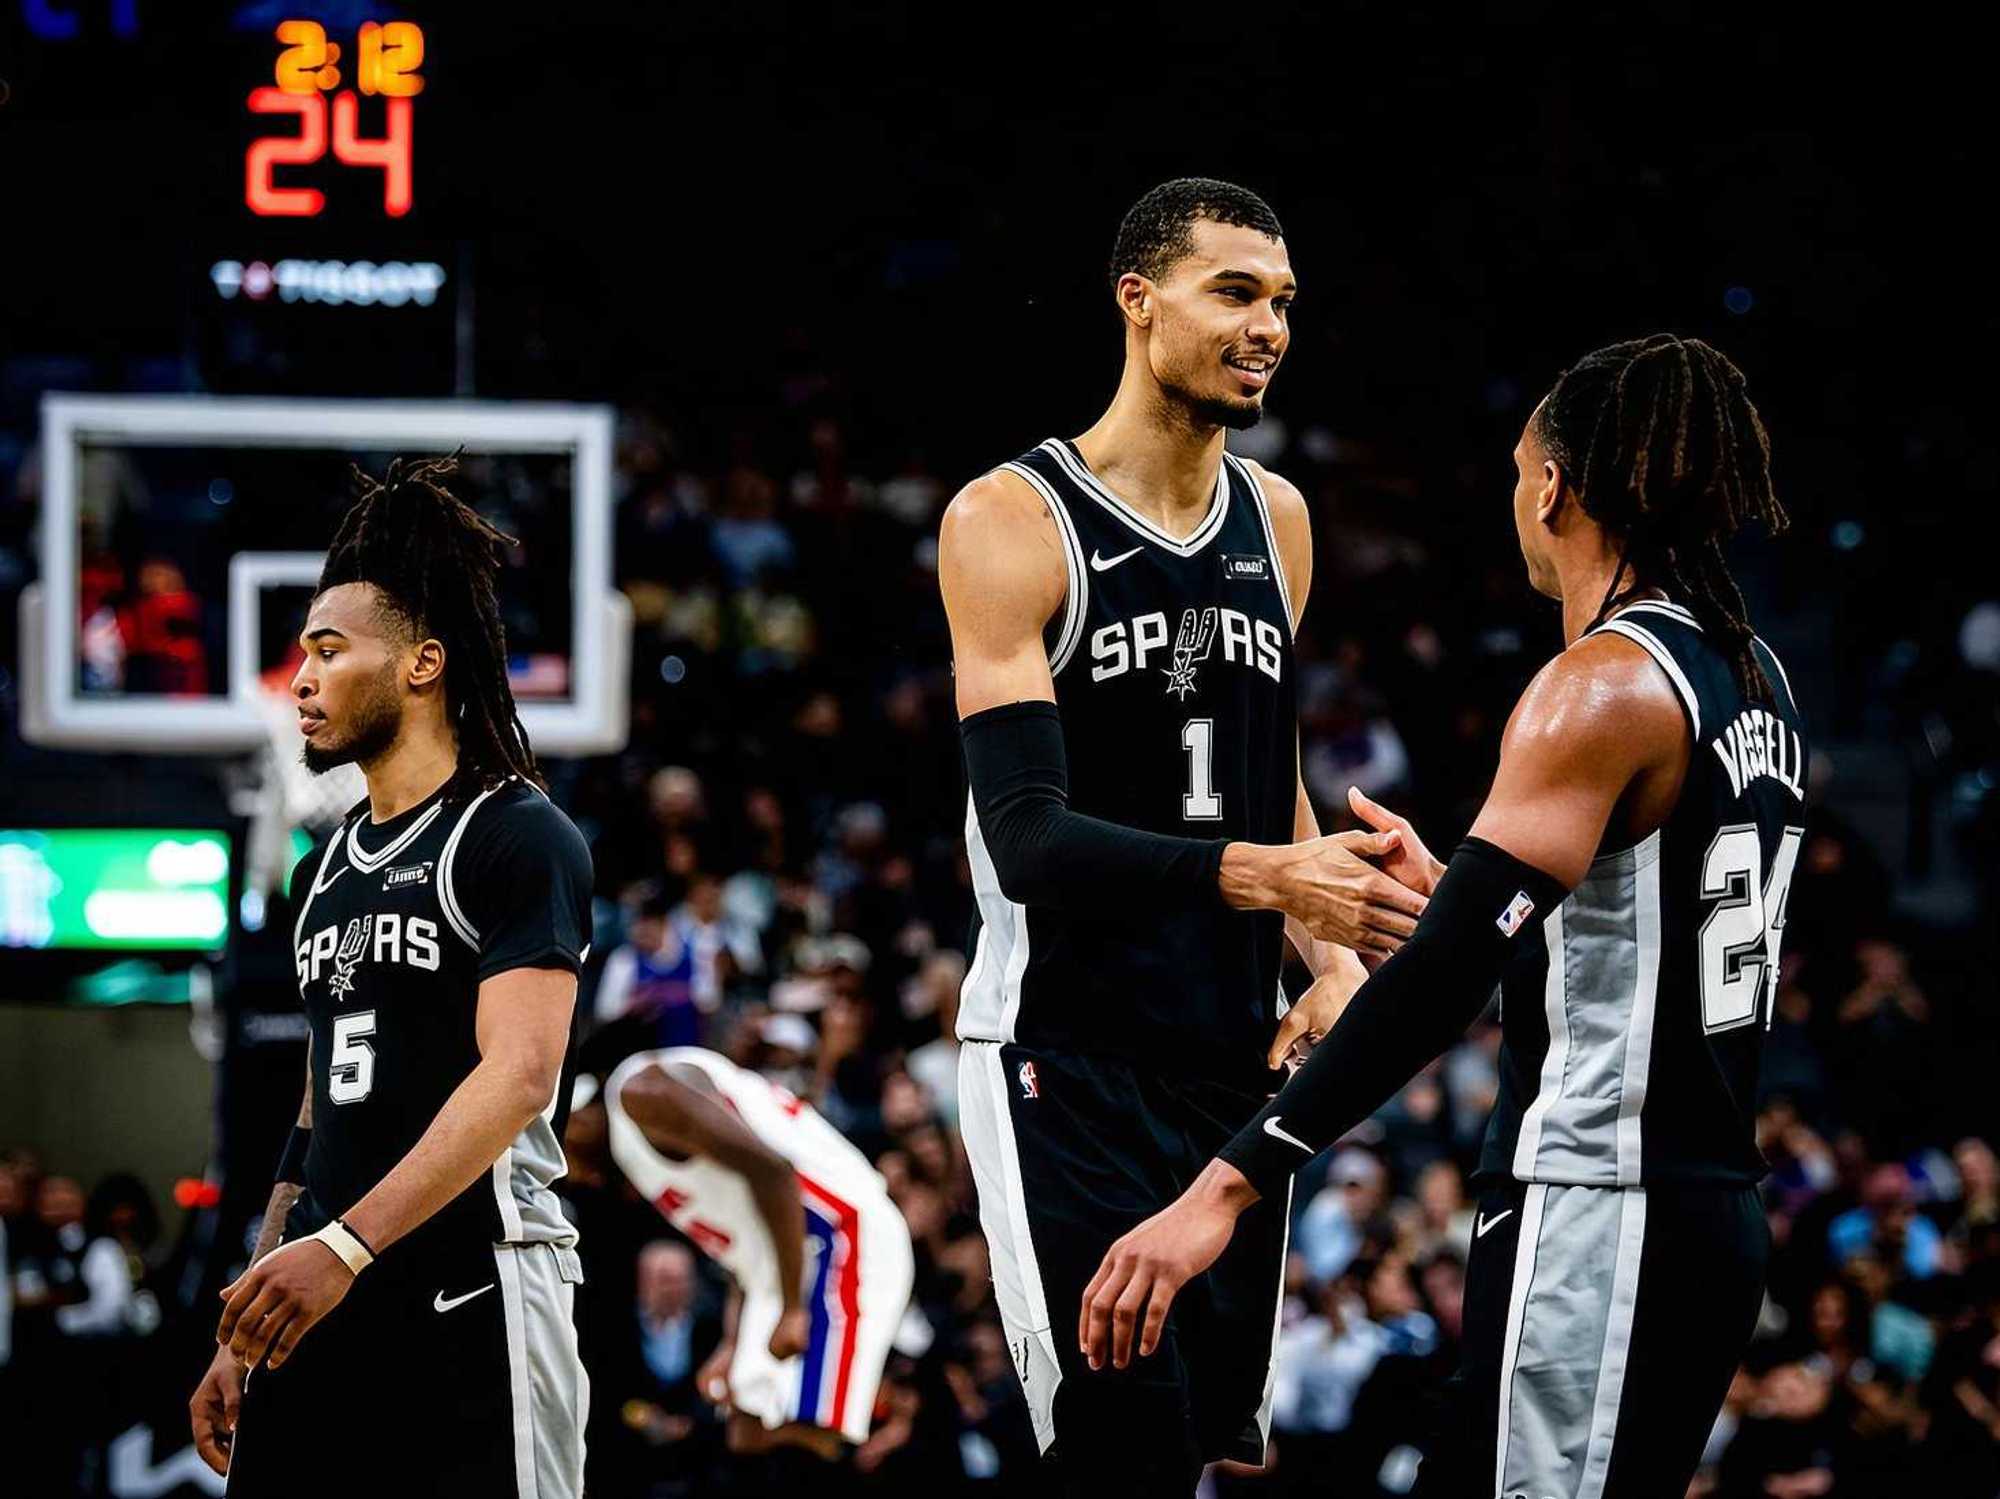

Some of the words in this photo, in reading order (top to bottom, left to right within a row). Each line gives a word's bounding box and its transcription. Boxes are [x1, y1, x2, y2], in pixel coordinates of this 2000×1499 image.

[245, 86, 413, 218] 24
[1091, 607, 1283, 702] SPURS
[1181, 718, 1223, 820] 1
[1712, 709, 1804, 801] VASSELL
[1698, 822, 1805, 1036] 24
[328, 1010, 377, 1105] 5
